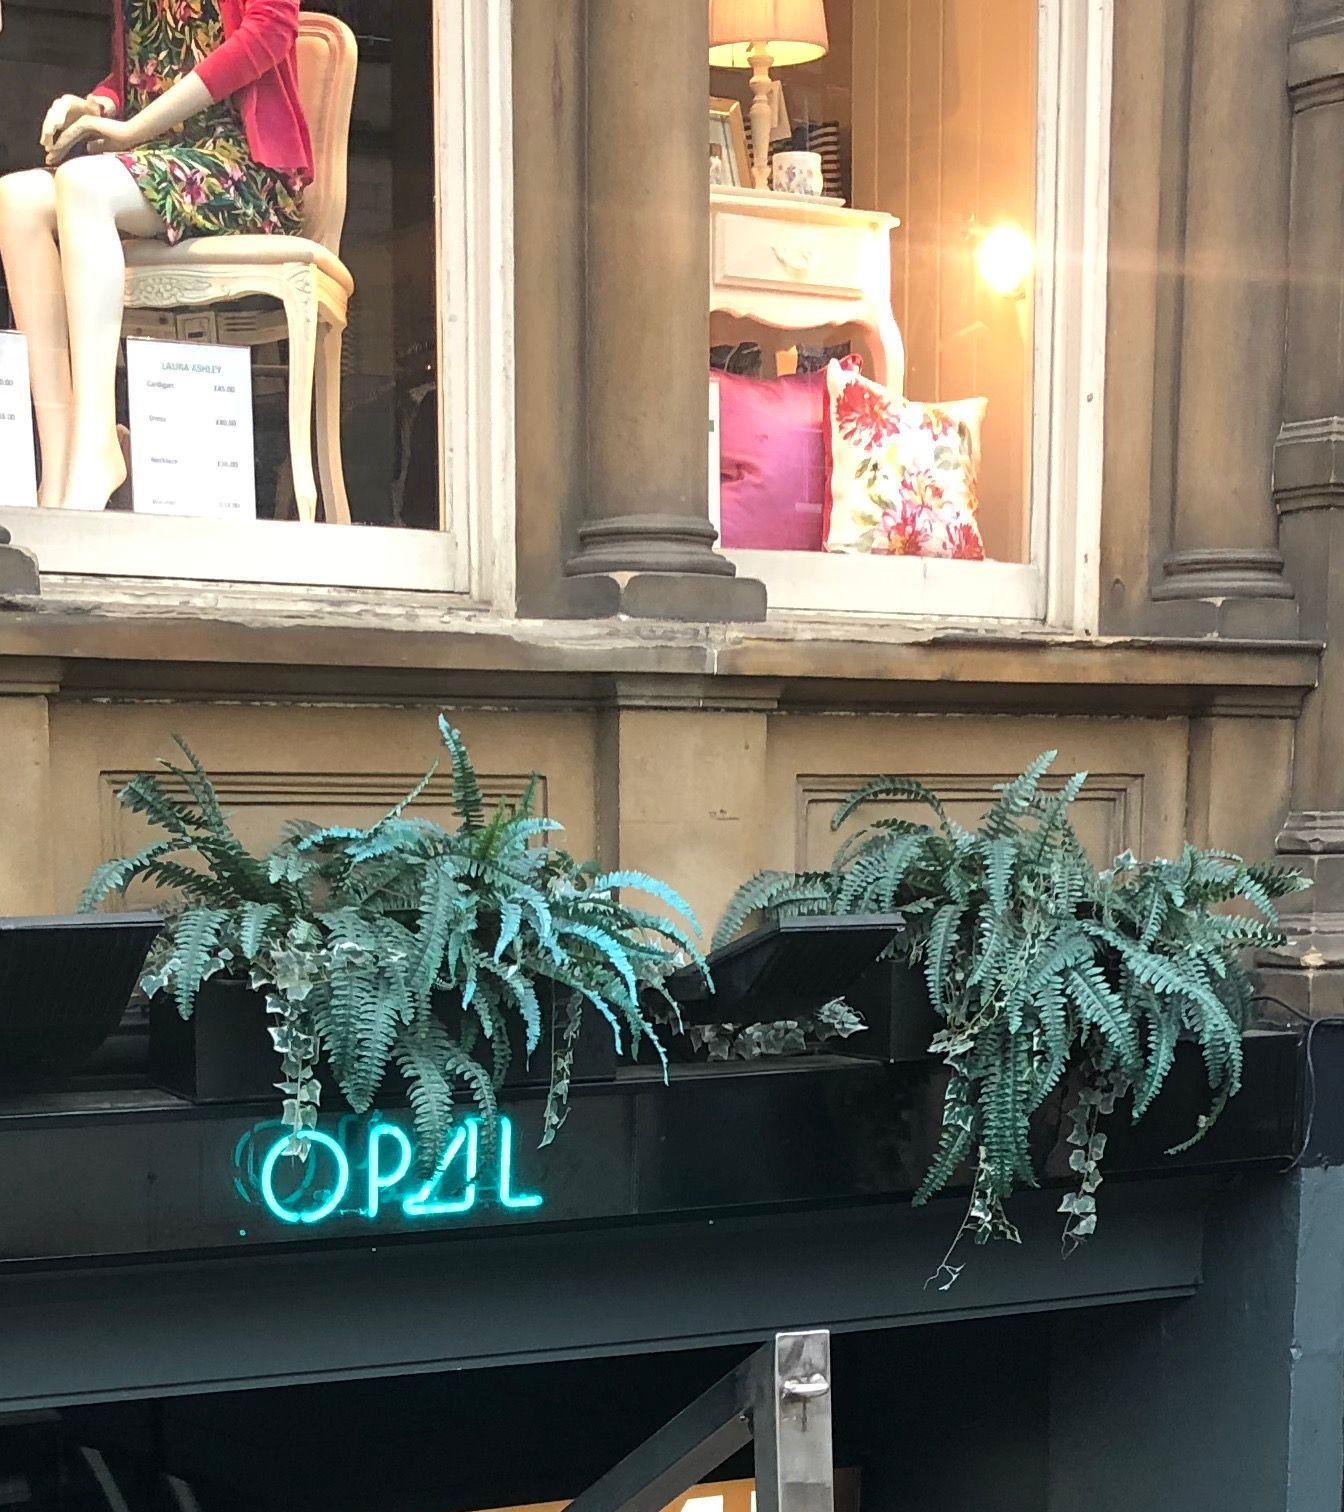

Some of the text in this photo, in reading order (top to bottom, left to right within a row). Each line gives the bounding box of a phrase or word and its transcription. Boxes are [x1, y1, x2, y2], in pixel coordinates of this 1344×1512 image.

[161, 362, 222, 374] LAURA ASHLEY
[261, 1117, 544, 1224] OPAL
